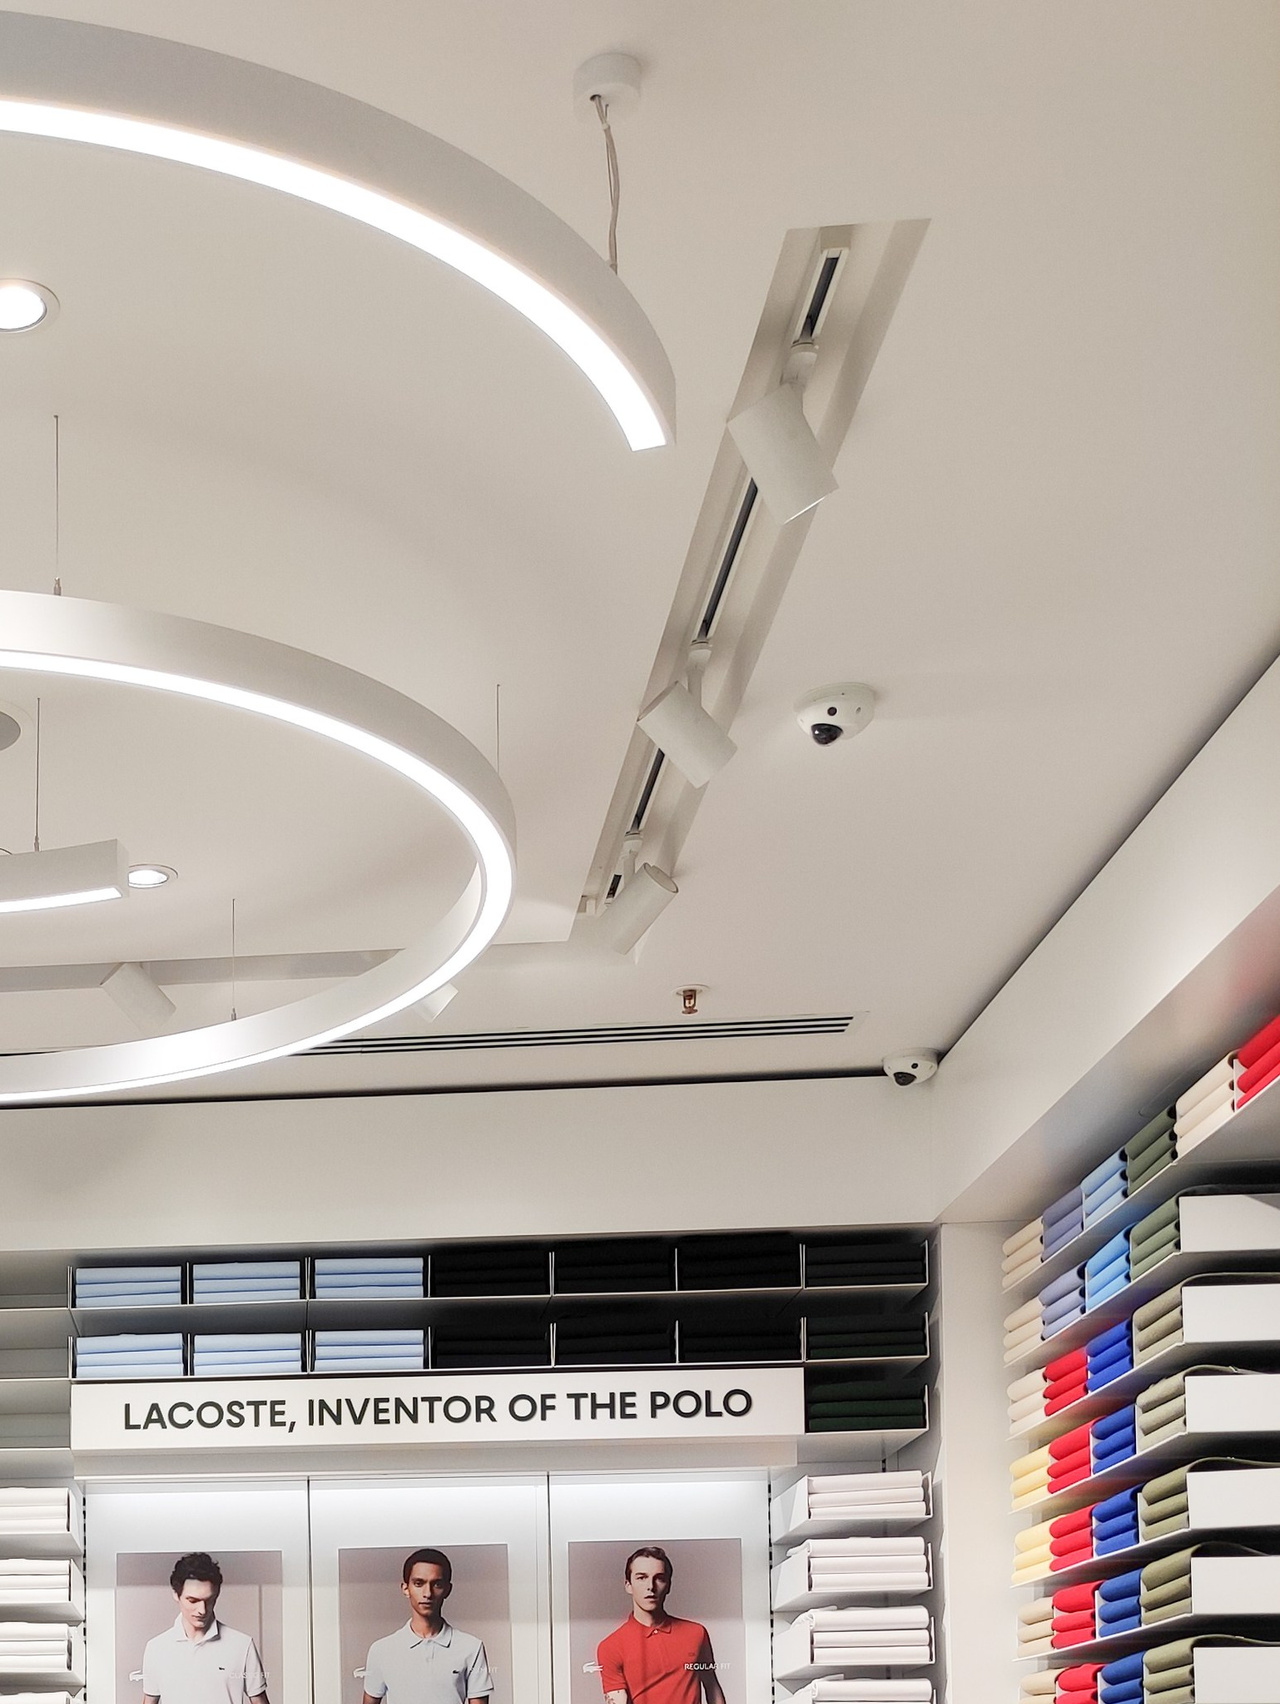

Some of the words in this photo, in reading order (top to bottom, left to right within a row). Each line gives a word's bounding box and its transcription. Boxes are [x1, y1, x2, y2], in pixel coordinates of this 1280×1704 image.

[124, 1400, 296, 1433] LACOSTE,
[308, 1395, 497, 1426] INVENTOR
[509, 1393, 557, 1422] OF
[566, 1391, 638, 1420] THE
[650, 1388, 753, 1419] POLO
[684, 1662, 719, 1670] REGULAR
[720, 1662, 731, 1670] FIT
